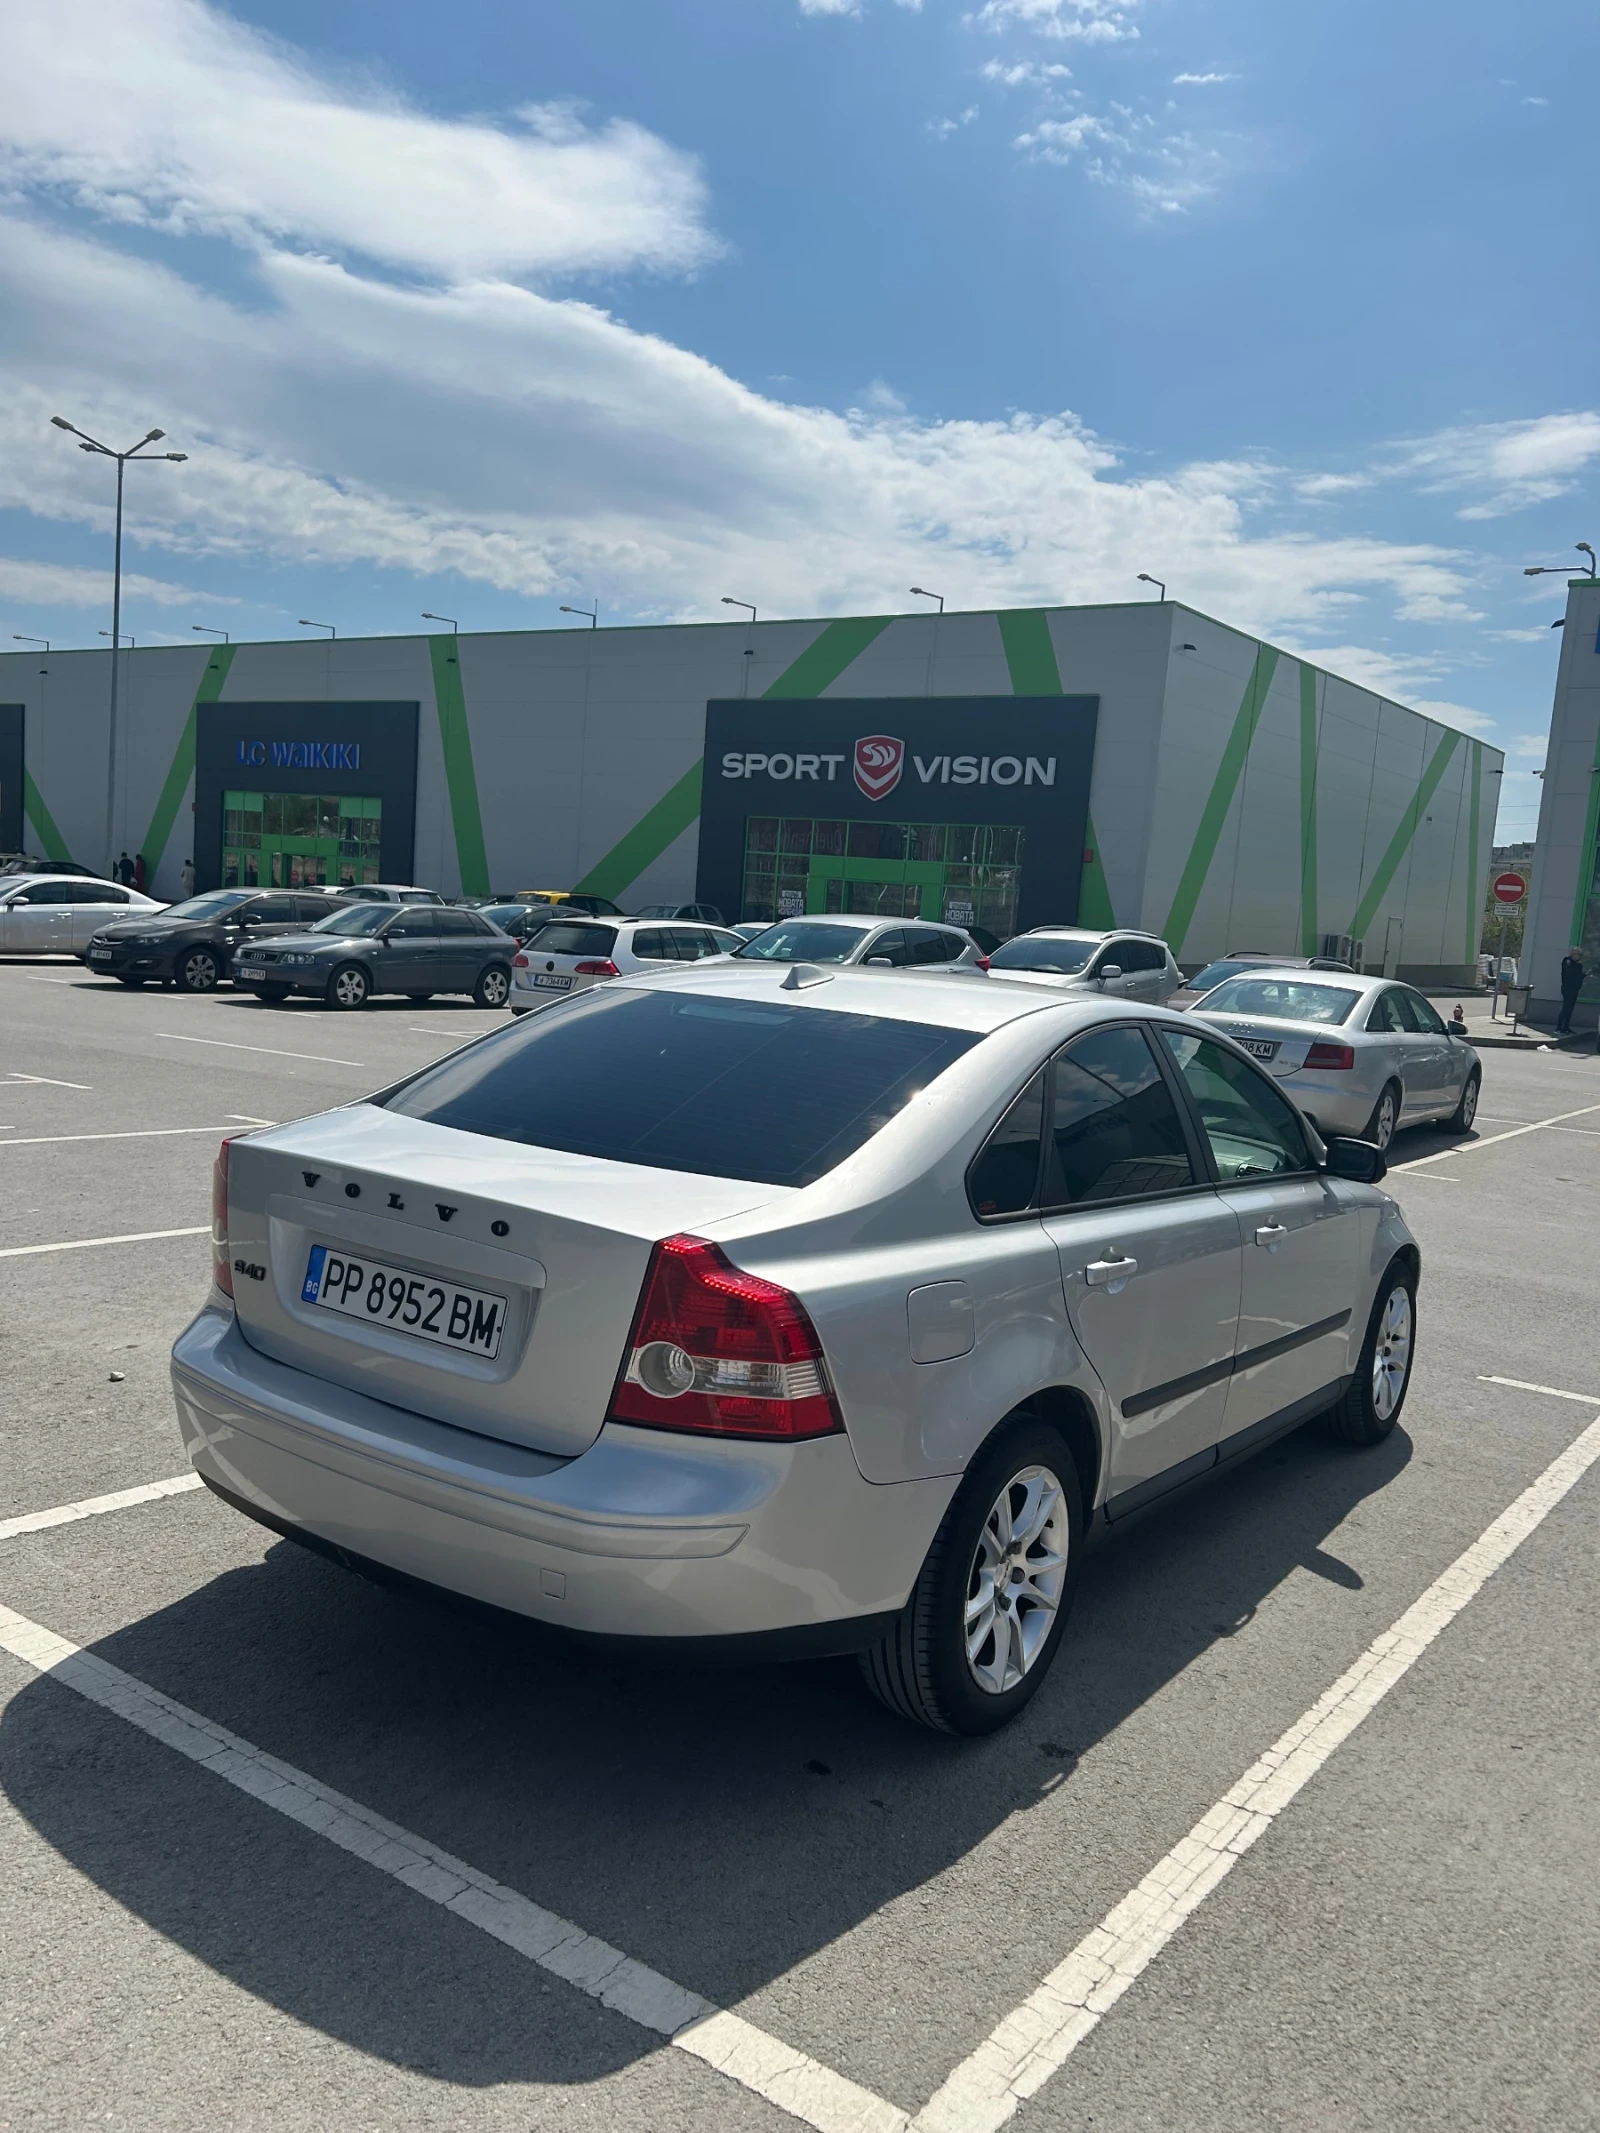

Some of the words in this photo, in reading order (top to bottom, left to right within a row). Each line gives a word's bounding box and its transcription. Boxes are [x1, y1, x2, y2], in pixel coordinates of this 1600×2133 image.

[237, 740, 266, 767] LC
[721, 752, 846, 781] SPORT
[912, 755, 1057, 786] VISION
[1255, 1043, 1271, 1055] KM
[301, 1170, 511, 1238] VOLVO
[305, 1279, 319, 1295] BG
[322, 1257, 365, 1305] PP
[365, 1271, 446, 1334] 8952
[446, 1293, 500, 1349] BM
